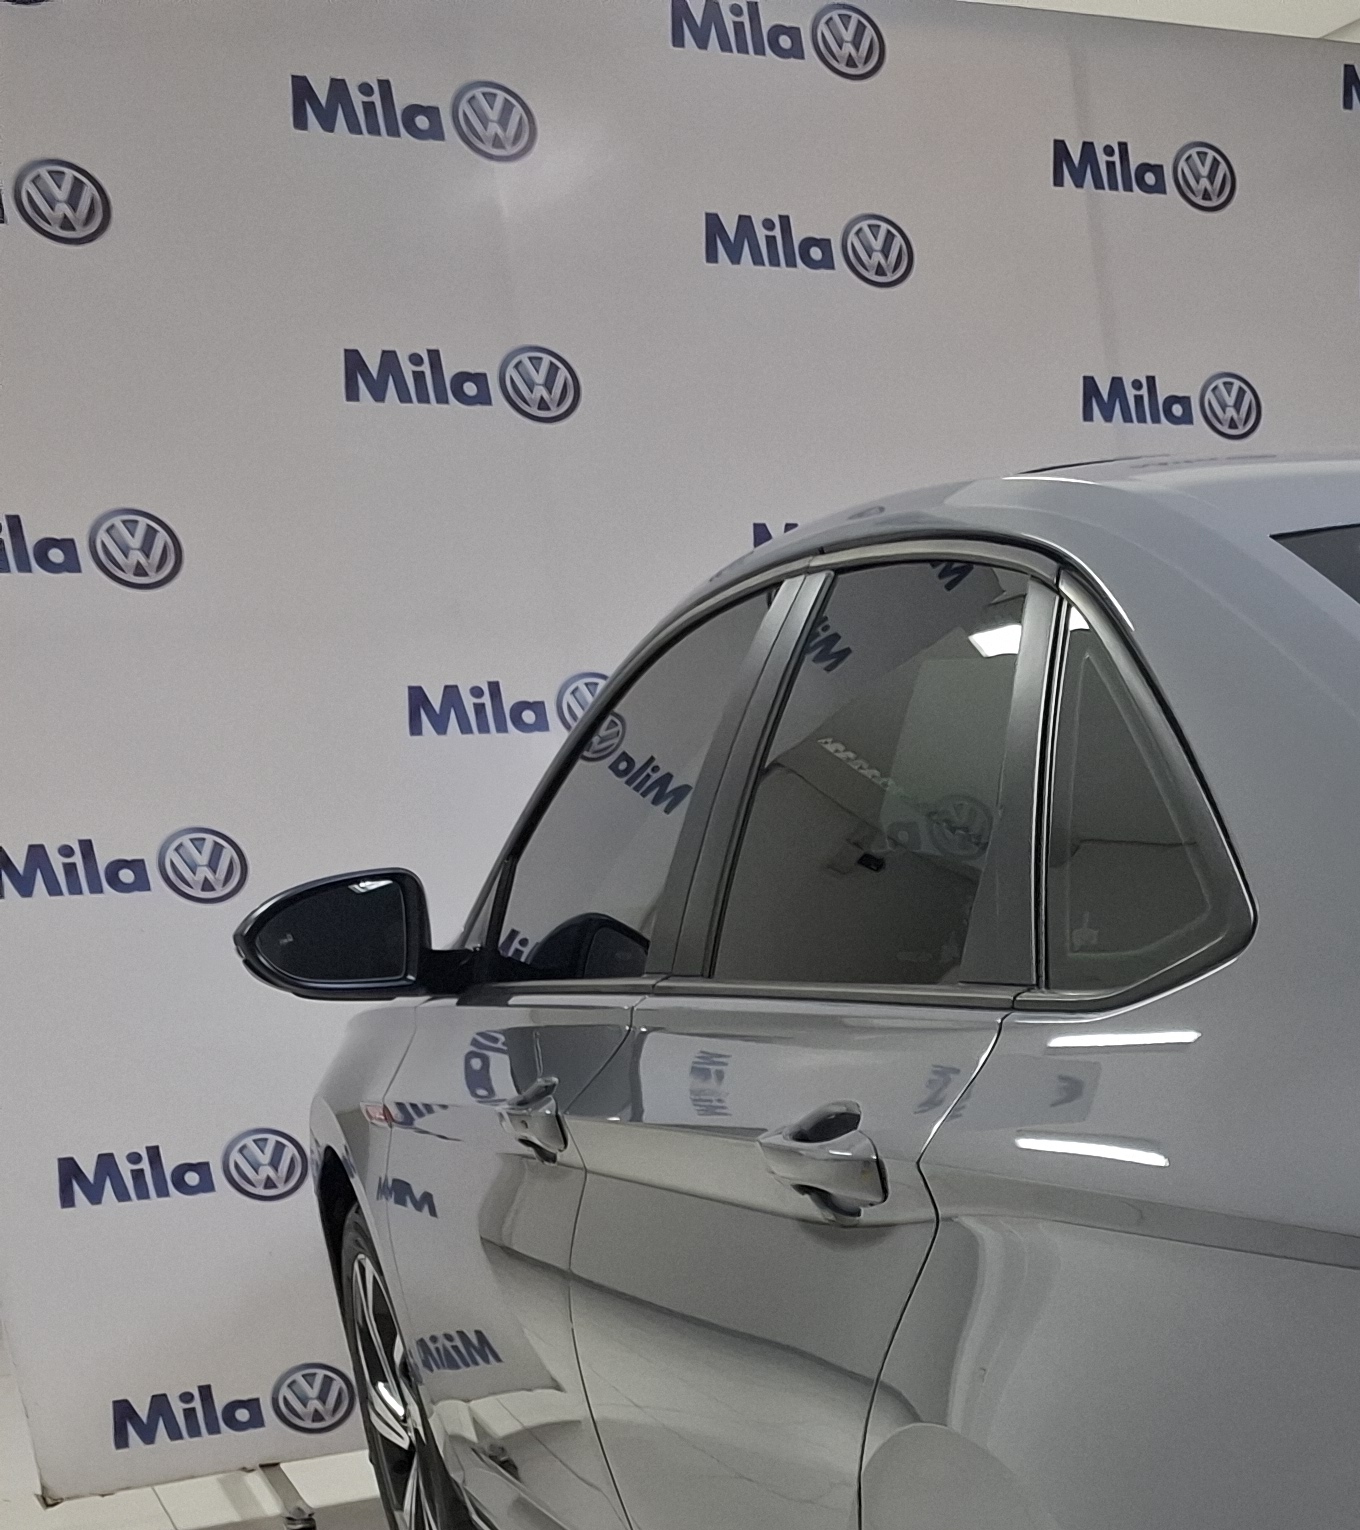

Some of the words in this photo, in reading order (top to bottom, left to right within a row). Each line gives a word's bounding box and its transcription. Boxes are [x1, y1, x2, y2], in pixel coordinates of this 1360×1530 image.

[671, 0, 805, 60] Mila
[291, 75, 445, 141] Mila
[1053, 139, 1167, 194] Mila
[705, 213, 835, 270] Mila
[344, 349, 492, 406] Mila
[1083, 376, 1193, 425] Mila
[408, 681, 549, 736] Mila
[0, 839, 151, 899] Mila
[58, 1145, 215, 1208] Mila
[112, 1384, 265, 1449] Mila
